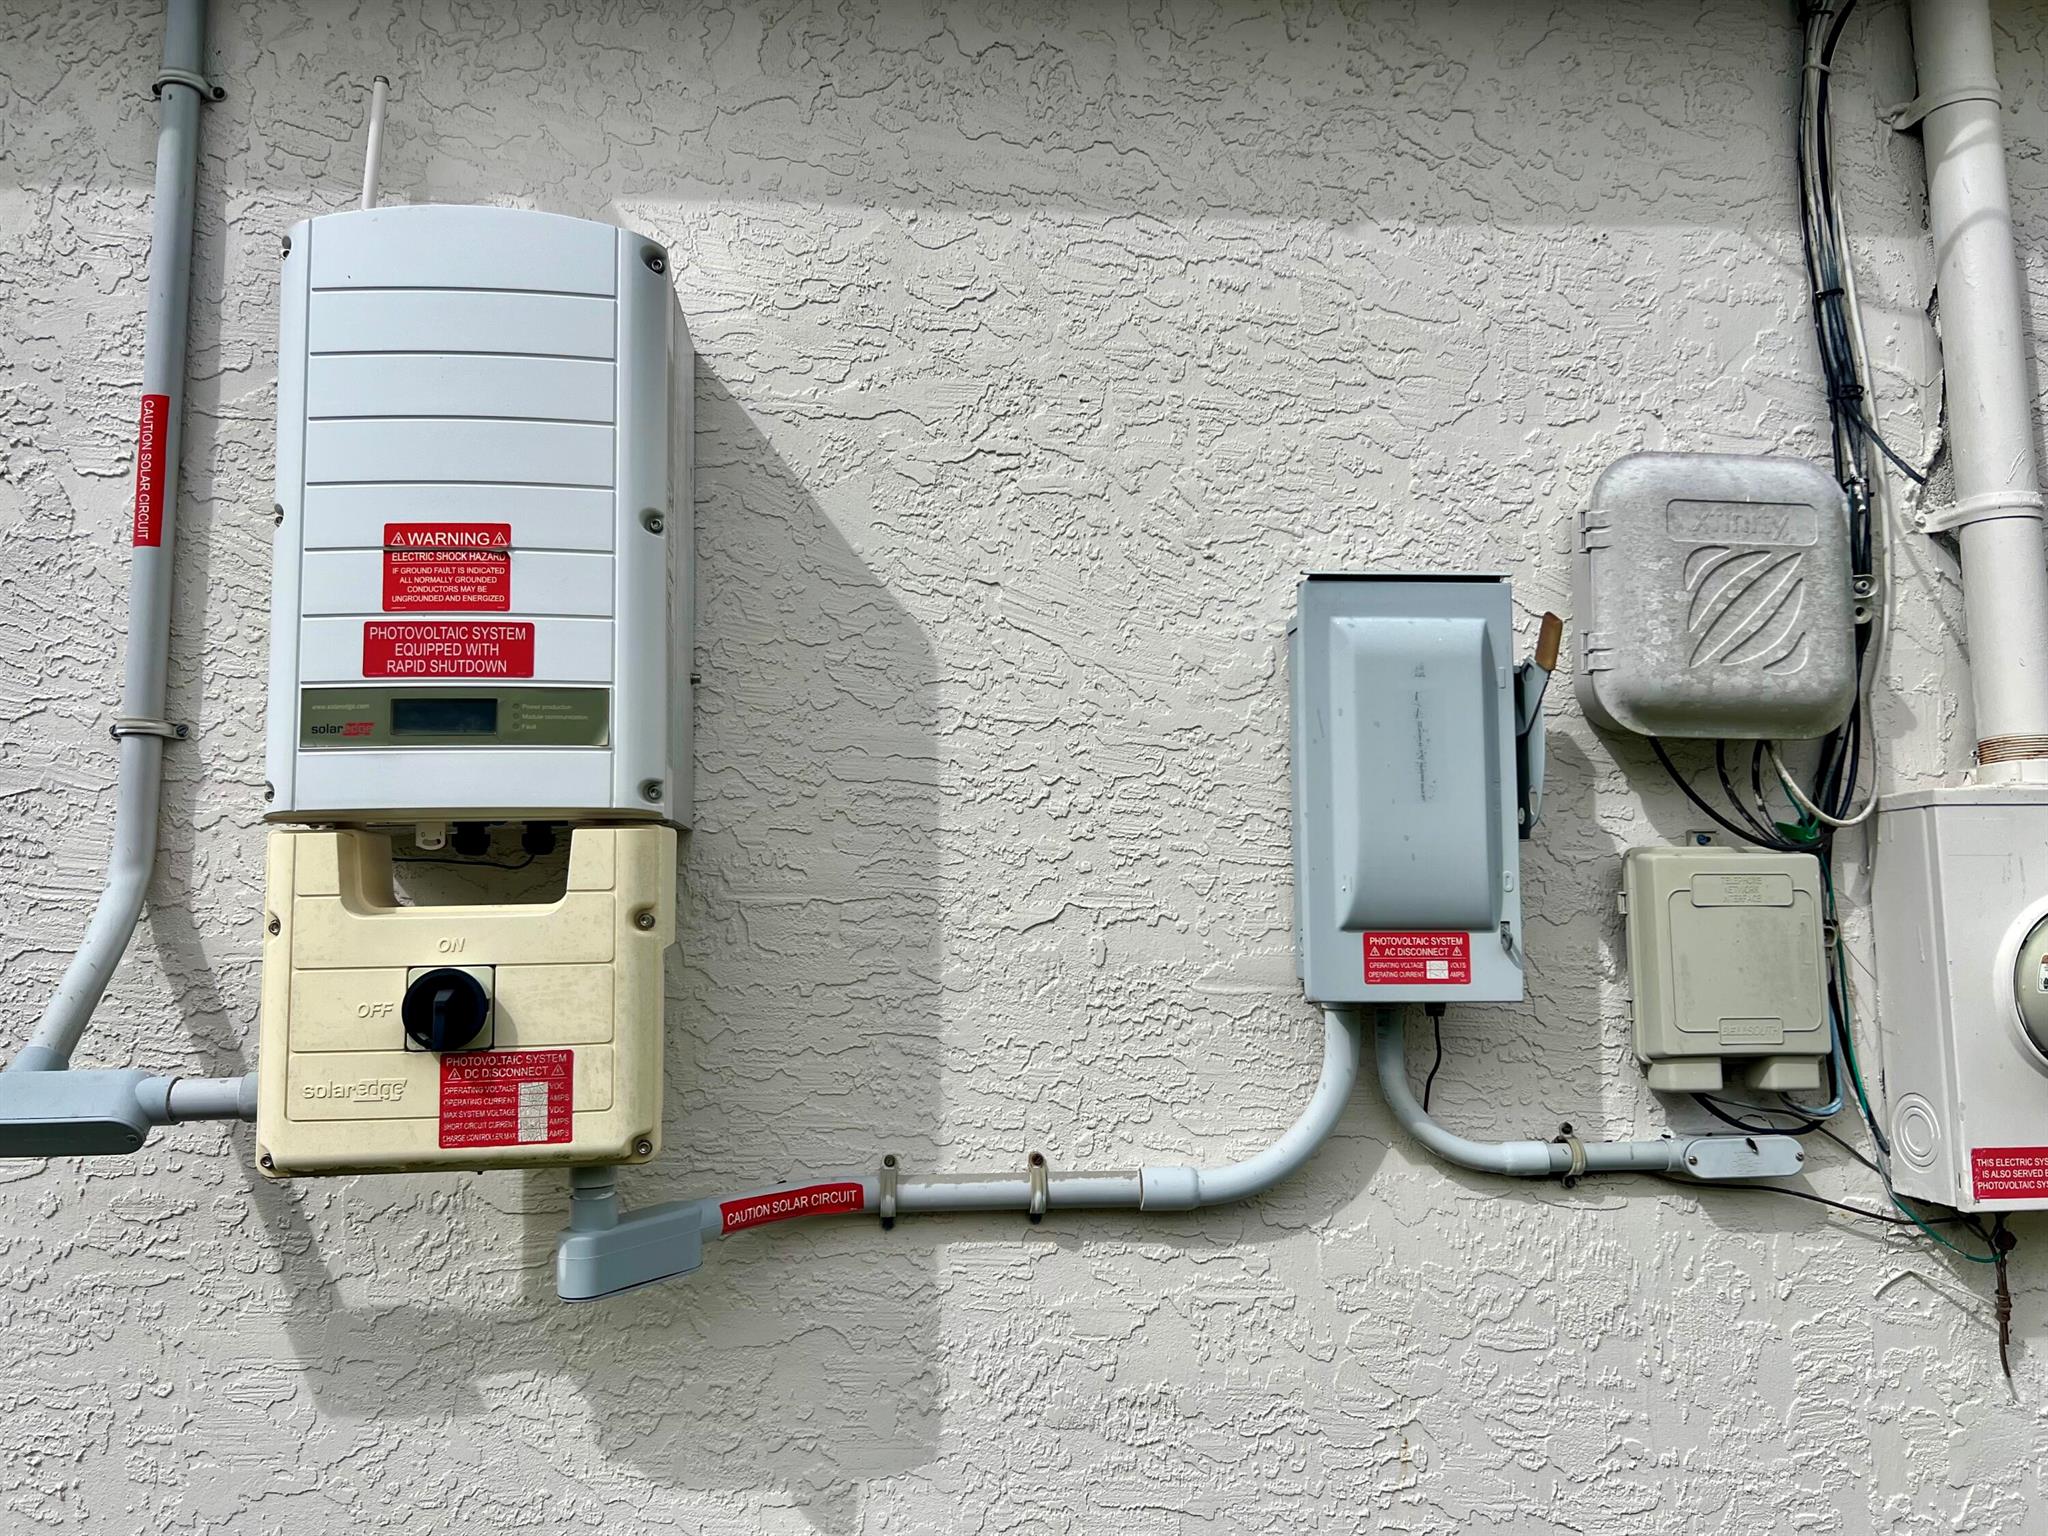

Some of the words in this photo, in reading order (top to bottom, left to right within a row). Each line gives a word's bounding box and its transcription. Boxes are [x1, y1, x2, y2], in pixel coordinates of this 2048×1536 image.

[141, 400, 154, 451] CAUTION
[139, 453, 152, 491] SOLAR
[136, 493, 150, 540] CIRCUIT
[408, 532, 490, 546] WARNING
[392, 552, 434, 562] ELECTRIC
[436, 552, 467, 562] SHOCK
[469, 552, 506, 562] HAZARD
[392, 567, 399, 575] IF
[400, 567, 433, 575] GROUND
[434, 566, 456, 575] FAULT
[458, 566, 465, 575] IS
[466, 567, 506, 575] INDICATED
[400, 576, 412, 584] ALL
[414, 576, 453, 584] NORMALLY
[454, 576, 498, 584] GROUNDED
[407, 585, 459, 593] CONDUCTORS
[460, 585, 475, 593] MAY
[477, 585, 488, 593] BE
[391, 595, 445, 603] UNGROUNDED
[446, 595, 461, 603] AND
[462, 595, 506, 603] ENERGIZED
[369, 626, 469, 641] PHOTOVOLTAIC
[472, 626, 527, 641] SYSTEM
[394, 643, 462, 657] EQUIPPED
[465, 643, 500, 657] WITH
[386, 660, 427, 673] RAPID
[429, 660, 508, 674] SHUTDOWN
[437, 937, 465, 953] ON
[1369, 937, 1430, 946] PHOTOVOLTAIC
[1430, 937, 1463, 946] SYSTEM
[1384, 948, 1396, 956] AC
[1397, 947, 1449, 956] DISCONNECT
[357, 1003, 393, 1018] OFF
[446, 1055, 524, 1067] PHOTOVOLTAIC
[525, 1053, 567, 1063] SYSTEM
[464, 1069, 480, 1079] DC
[481, 1065, 549, 1077] DISCONNECT
[444, 1085, 485, 1095] OPERATING
[485, 1084, 517, 1093] VOLTAGE
[443, 1098, 483, 1106] OPERATING
[483, 1096, 516, 1105] CURRENT
[443, 1111, 459, 1119] MAX
[458, 1109, 486, 1118] SYSTEM
[486, 1108, 516, 1117] VOLTAGE
[549, 1106, 566, 1114] VDC
[548, 1117, 570, 1125] AMPS
[548, 1130, 570, 1138] AMPS
[1976, 1158, 1995, 1167] THIS
[1996, 1158, 2033, 1167] ELECTRIC
[1982, 1171, 1990, 1179] IS
[1991, 1170, 2011, 1179] ALSO
[2013, 1169, 2043, 1178] SERVED
[1977, 1182, 2035, 1190] PHOTOVOLTAIC
[727, 1206, 770, 1226] CAUTION
[772, 1196, 809, 1214] SOLAR
[811, 1190, 857, 1206] CIRCUIT
